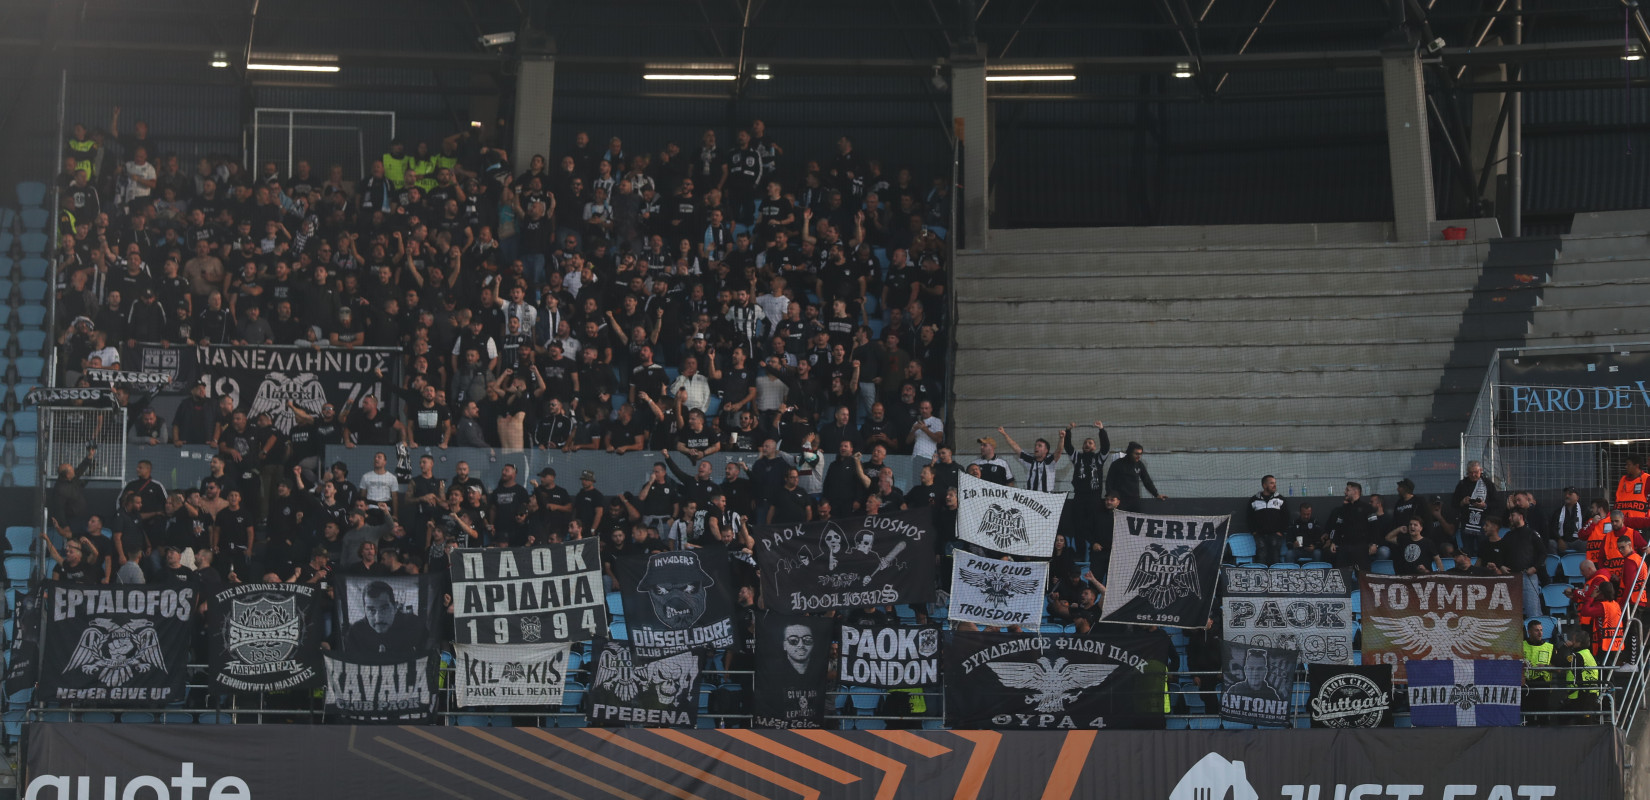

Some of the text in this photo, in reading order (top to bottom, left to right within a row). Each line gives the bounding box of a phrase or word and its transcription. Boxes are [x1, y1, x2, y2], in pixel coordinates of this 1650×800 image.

[196, 345, 391, 373] ΠΑΝΕΛΛΗΝΙΟΣ
[88, 371, 170, 384] THASSOS
[28, 389, 102, 405] THASSOS
[1511, 386, 1585, 413] FARO
[1593, 386, 1633, 410] DE
[981, 488, 1008, 499] ΠΑΟΚ
[1013, 492, 1052, 519] ΝΕΑΠΟΛΗΣ
[762, 523, 806, 552] PAOK
[864, 515, 927, 541] EVOSMOS
[1126, 516, 1216, 541] VERIA
[462, 543, 588, 580] ΠΑΟΚ
[654, 555, 694, 567] INVADERS
[967, 559, 1032, 577] PAOK CLUB
[1151, 564, 1183, 572] ΠΑΟΚ
[216, 583, 315, 602] ΣΤΙΣ ΔΥΣΚΟΛΕΣ ΣΤΙΓΜΕΣ
[1226, 568, 1347, 594] EDESSA
[54, 586, 193, 621] EPTALOFOS
[463, 575, 595, 614] ΑΡΙΔΑΙΑ
[960, 603, 1032, 623] TROISDORF
[1136, 613, 1181, 623] est. 1990
[1229, 601, 1347, 629] PAOK
[230, 622, 299, 645] SERRES
[632, 618, 732, 647] DÜSSELDORF
[841, 625, 919, 660] PAOK
[250, 649, 281, 661] 1989
[636, 647, 661, 657] CLUB
[961, 637, 1149, 674] ΣΥΝΔΕΣΜΟΣ ΦΙΛΩΝ ΠΑΟΚ
[1304, 635, 1348, 662] 95
[275, 666, 316, 690] ΜΑΧΗΤΕΣ
[323, 655, 431, 705] KAVALA
[841, 656, 938, 686] LONDON
[56, 687, 171, 699] NEVER GIVE UP
[467, 686, 562, 697] PAOK TILL DEATH
[1322, 678, 1376, 698] PAOK CLUB
[1413, 686, 1519, 705] PANO RAMA
[336, 697, 421, 711] CLUB PAOK
[592, 703, 692, 725] ΓΡΕΒΕΝΑ
[1221, 692, 1289, 715] ΑΝΤΩΝΗ
[1311, 691, 1390, 720] Stuttgart
[992, 713, 1107, 729] ΘΥΡΑ 4
